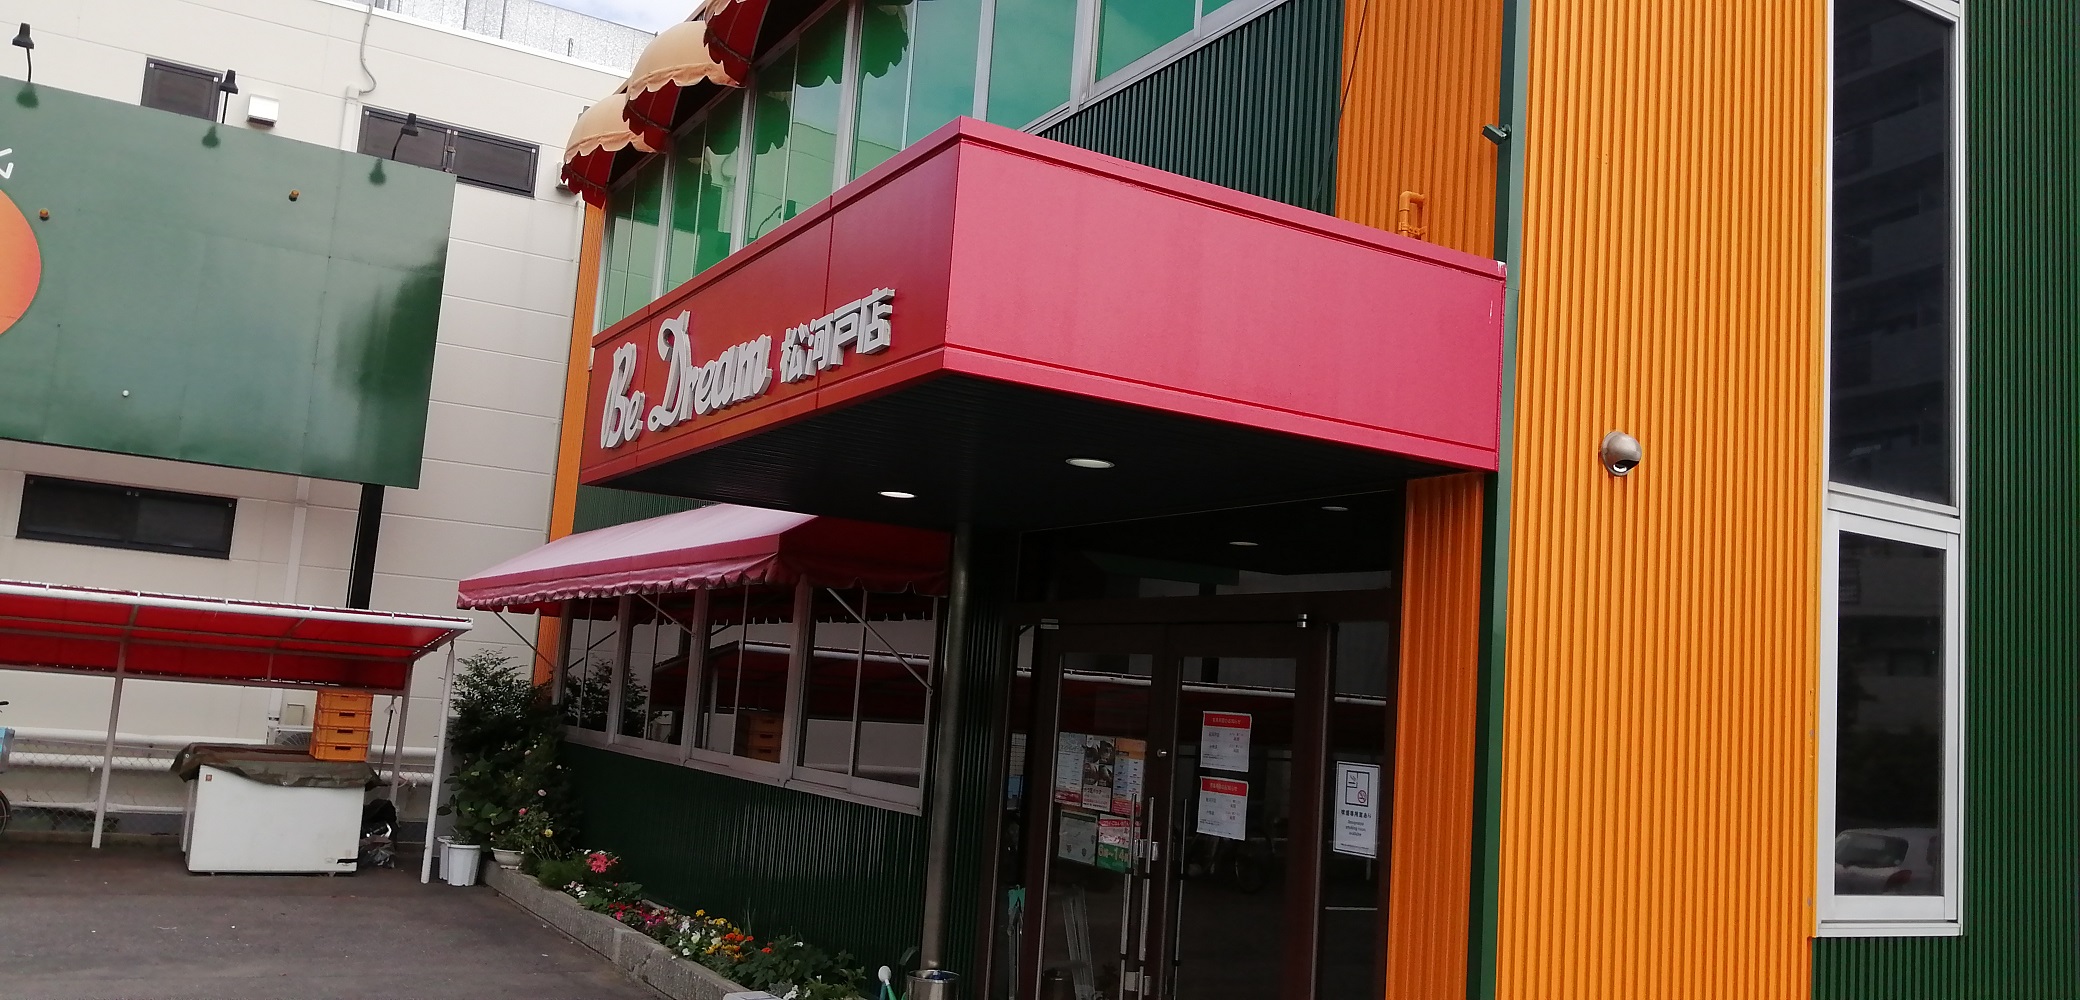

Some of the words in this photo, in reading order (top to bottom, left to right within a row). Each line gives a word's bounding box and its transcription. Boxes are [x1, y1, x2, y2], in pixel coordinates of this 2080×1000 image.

[647, 309, 773, 432] Dream
[780, 286, 896, 383] 松河戸店
